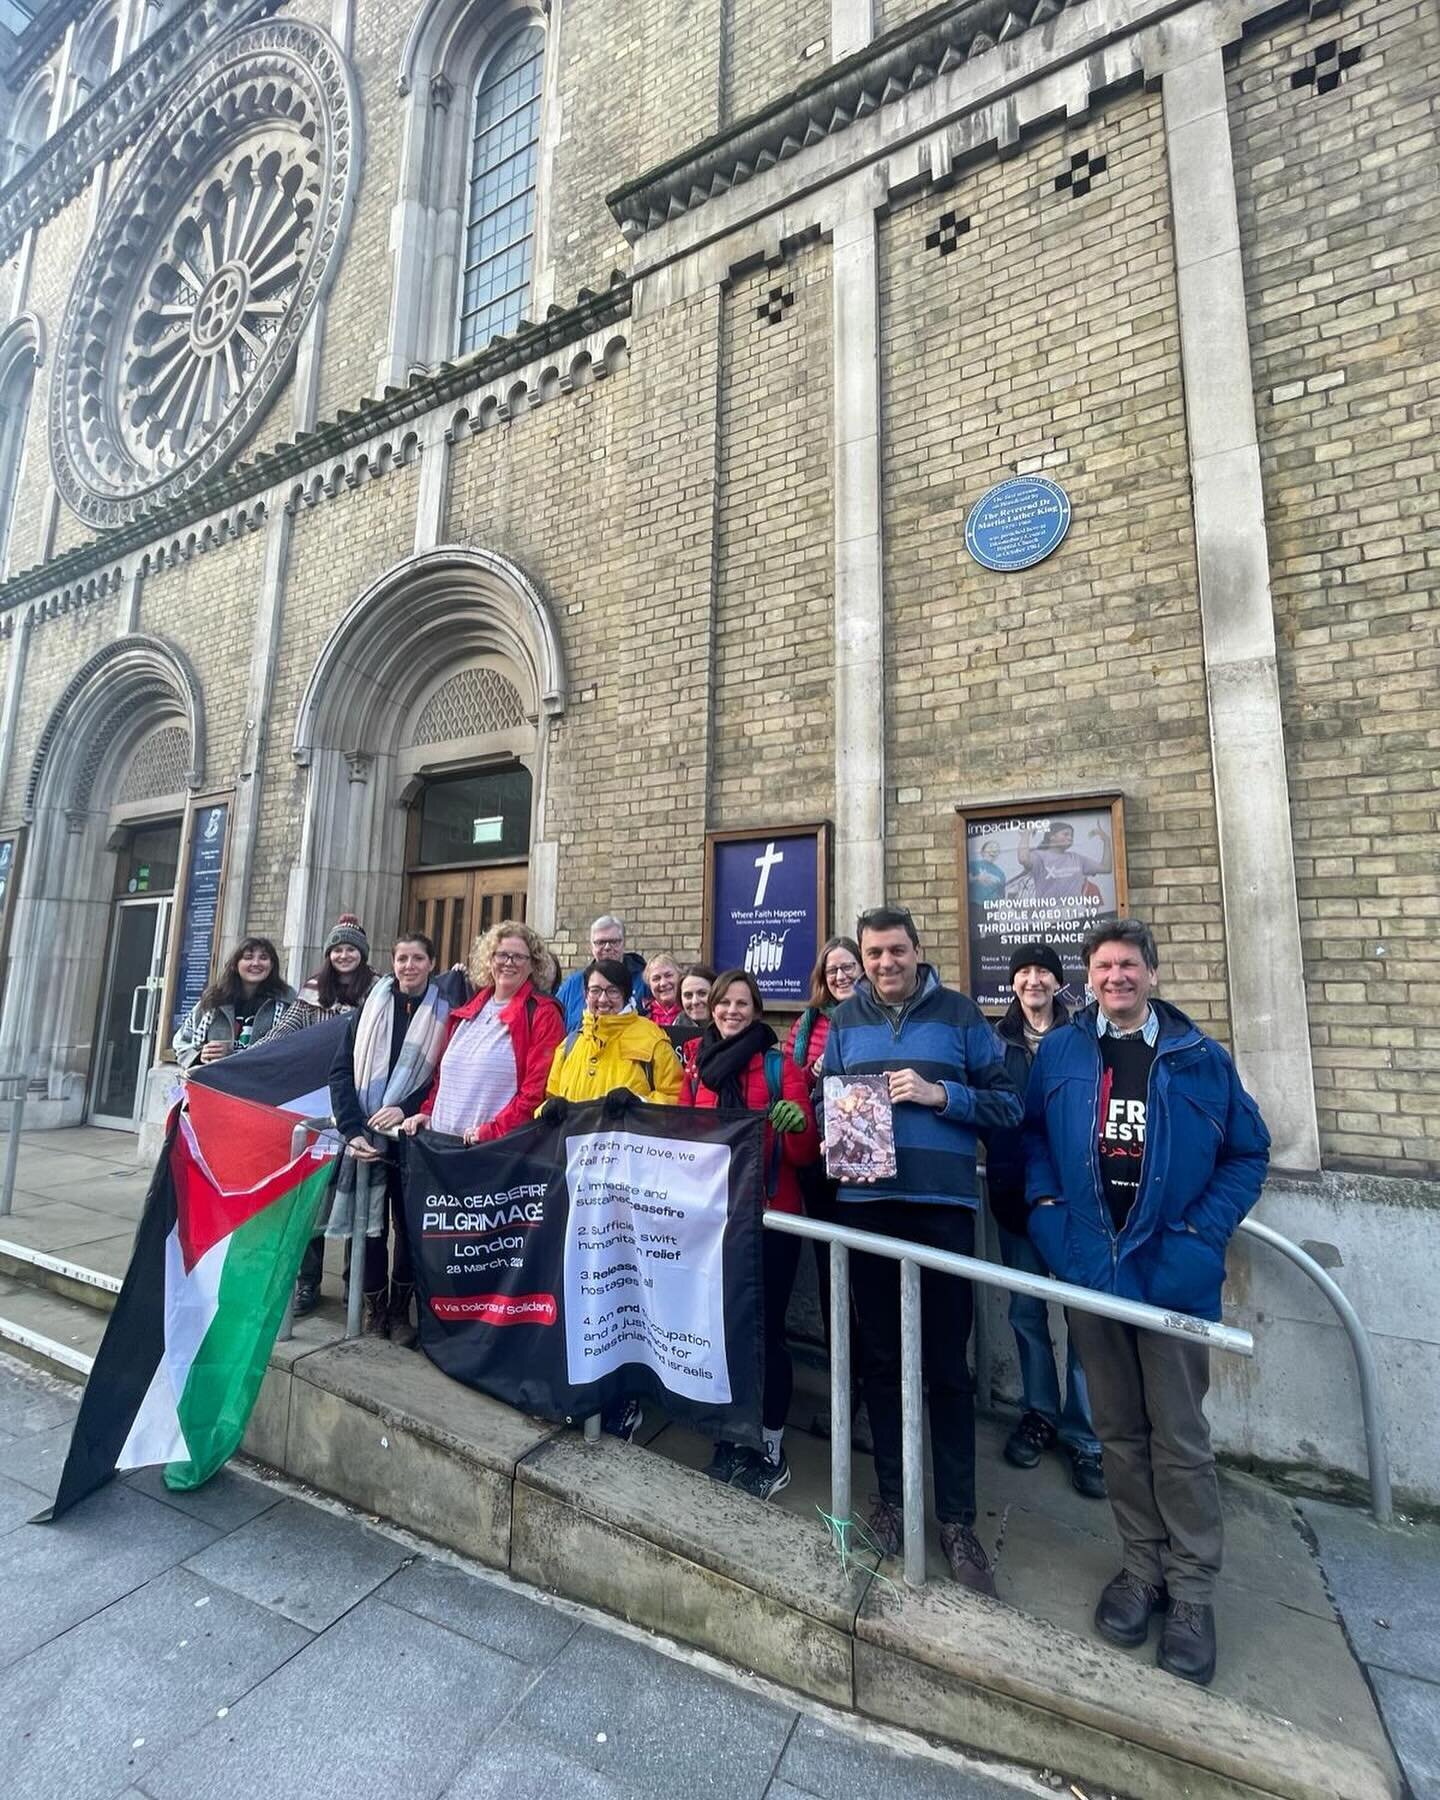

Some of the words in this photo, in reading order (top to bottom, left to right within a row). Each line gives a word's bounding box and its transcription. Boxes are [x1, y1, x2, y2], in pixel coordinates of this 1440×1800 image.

[983, 512, 999, 521] The
[1000, 502, 1038, 517] Reverend
[1039, 499, 1051, 508] Dr
[977, 518, 1006, 530] Martin
[1007, 510, 1037, 523] Luther
[1037, 505, 1058, 516] King
[983, 897, 1057, 910] EMPOWERING
[1060, 895, 1100, 906] YOUNG
[730, 910, 754, 919] Where
[754, 908, 772, 918] Faith
[773, 908, 807, 919] Happens
[986, 910, 1029, 921] PEOPLE
[1031, 909, 1062, 920] AGED
[1066, 908, 1098, 919] 11-19
[977, 922, 1030, 933] THROUGH
[1032, 920, 1080, 932] HIP-HOP
[1000, 934, 1043, 945] STREET
[1045, 933, 1085, 944] DANCE
[784, 978, 801, 987] Here
[977, 996, 1015, 1005] @impact
[1109, 1098, 1146, 1123] FR
[1104, 1122, 1146, 1142] EST
[593, 1140, 621, 1151] faith
[646, 1146, 675, 1160] love,
[678, 1152, 696, 1162] we
[579, 1155, 598, 1167] call
[643, 1188, 668, 1200] and
[576, 1194, 631, 1208] sustaine
[640, 1233, 678, 1246] swift
[454, 1236, 524, 1257] London
[645, 1248, 682, 1261] relief
[446, 1265, 462, 1274] 28
[592, 1262, 638, 1280] Release
[581, 1276, 639, 1295] hostages
[443, 1303, 460, 1312] Via
[598, 1311, 615, 1325] An
[616, 1304, 640, 1314] end
[583, 1328, 609, 1342] and
[611, 1322, 619, 1333] a
[622, 1316, 647, 1330] just
[671, 1345, 692, 1360] for
